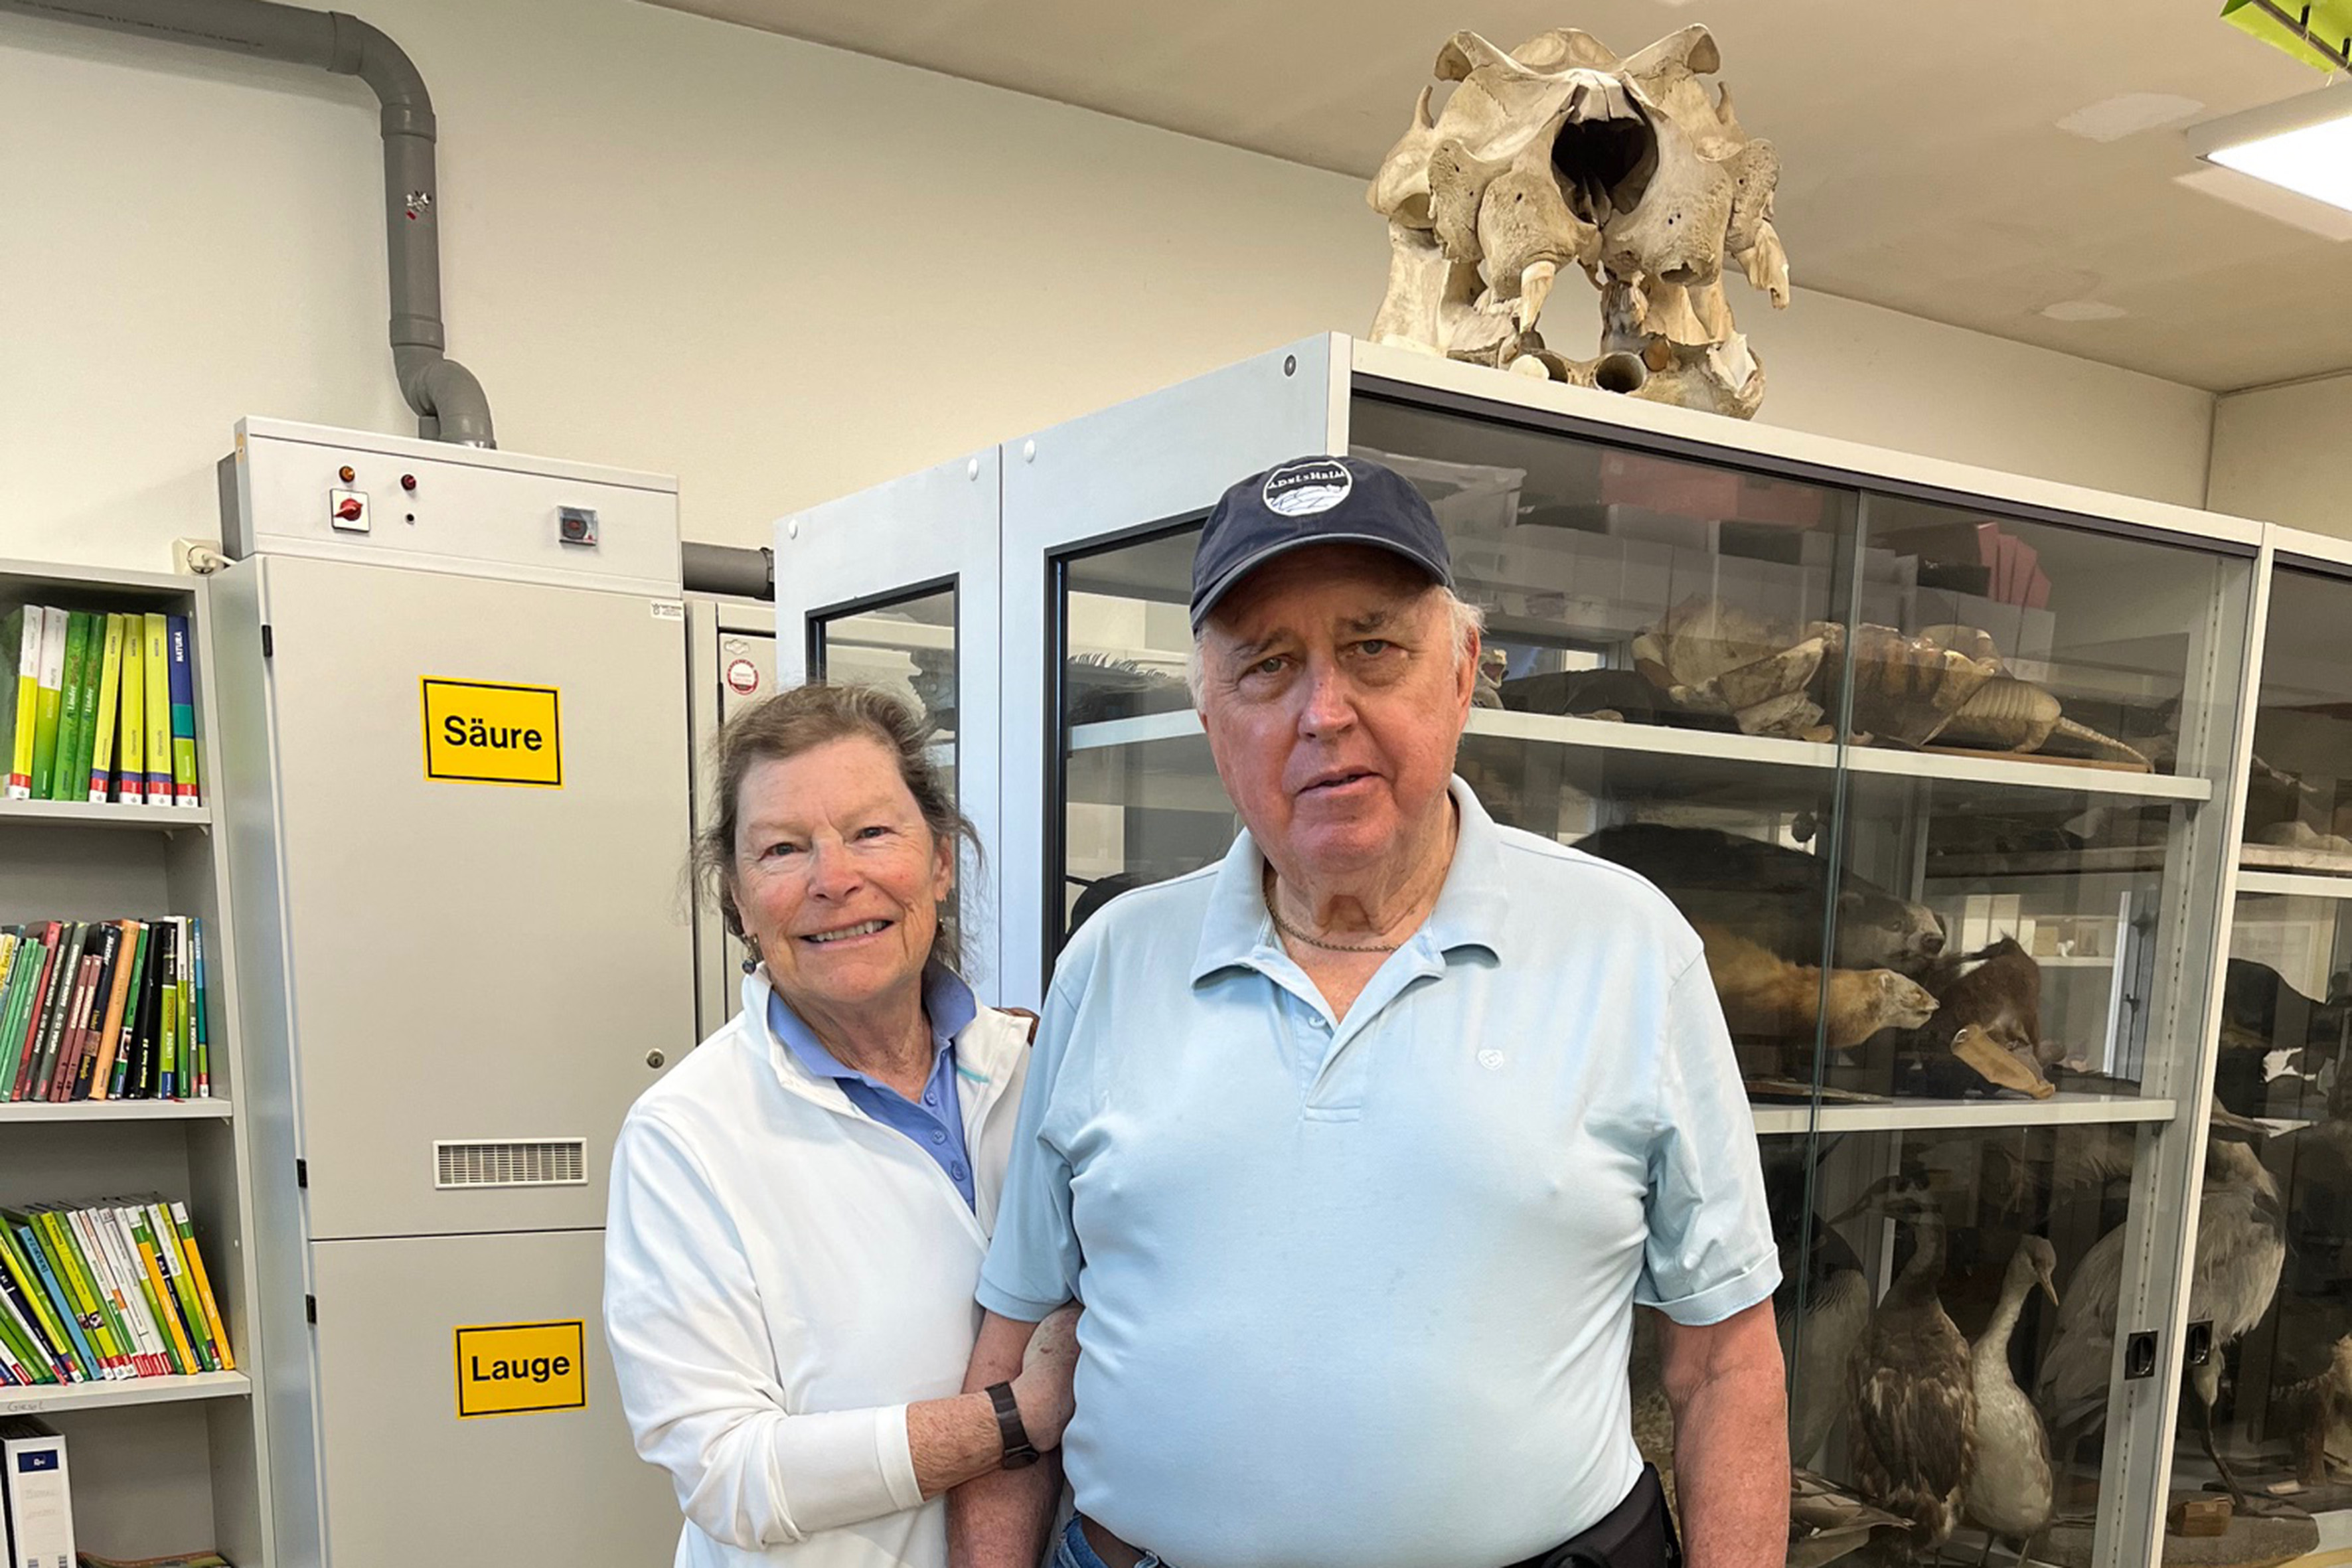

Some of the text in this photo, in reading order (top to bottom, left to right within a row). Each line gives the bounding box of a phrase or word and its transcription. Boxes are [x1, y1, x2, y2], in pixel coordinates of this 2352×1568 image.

[174, 631, 184, 663] NATURA
[67, 685, 77, 710] Linder
[85, 688, 94, 713] Linder
[444, 715, 542, 751] Säure
[33, 1029, 44, 1054] NATURA
[49, 1030, 60, 1054] NATURA
[471, 1356, 570, 1383] Lauge
